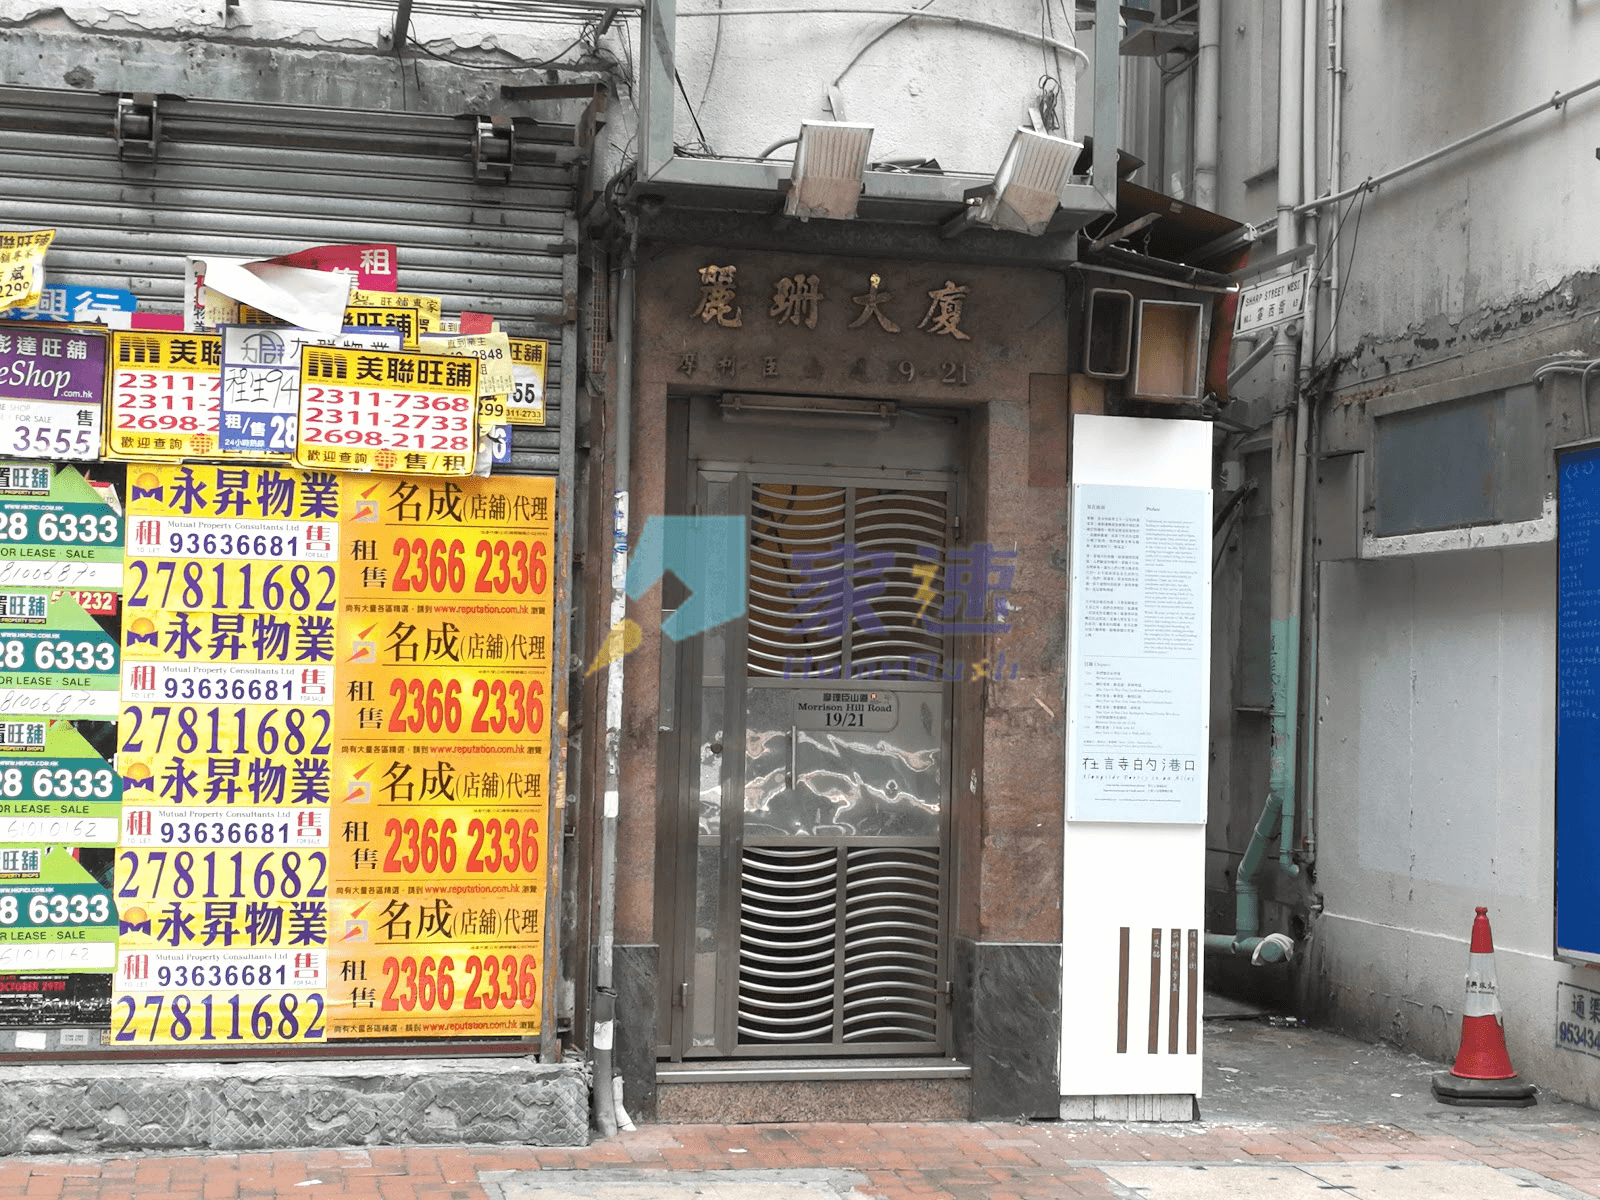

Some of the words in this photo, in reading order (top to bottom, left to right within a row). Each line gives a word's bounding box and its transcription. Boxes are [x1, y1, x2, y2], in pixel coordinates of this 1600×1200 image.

[360, 249, 391, 275] 租
[1246, 293, 1263, 305] SHARP
[1264, 285, 1285, 301] STREET
[1287, 279, 1301, 293] WEST
[356, 355, 472, 388] 美聯旺舖
[306, 387, 470, 412] 2311-7368
[16, 414, 30, 422] FOR
[34, 415, 51, 423] SALE
[77, 410, 93, 426] 售
[305, 407, 468, 432] 2311-2733
[13, 425, 91, 455] 3555
[120, 436, 184, 451] 歡迎查詢
[304, 427, 469, 451] 2698-2128
[307, 449, 368, 464] 歡迎查詢
[168, 467, 339, 519] 永昇物業
[38, 513, 118, 543] 6333
[136, 520, 161, 545] 租
[306, 525, 331, 551] 售
[20, 549, 55, 557] LEASE
[66, 550, 94, 558] SALE
[170, 533, 297, 557] 93636681
[351, 539, 378, 561] 租
[360, 566, 387, 589] 售
[392, 537, 465, 593] 2366
[474, 540, 547, 595] 2336
[128, 560, 336, 612] 27811682
[163, 612, 334, 662] 永昇物業
[35, 641, 115, 670] 6333
[17, 677, 52, 685] LEASE
[62, 678, 91, 686] SALE
[131, 665, 156, 691] 租
[164, 678, 292, 701] 93636681
[301, 669, 326, 694] 售
[346, 680, 375, 702] 租
[357, 707, 383, 730] 售
[388, 678, 462, 733] 2366
[471, 679, 544, 734] 2336
[798, 703, 843, 712] Morrison
[846, 703, 864, 712] Hill
[867, 704, 892, 712] Road
[122, 706, 331, 755] 27811682
[825, 712, 865, 727] 19/21
[33, 769, 113, 798] 6333
[160, 756, 330, 805] 永昇物業
[15, 805, 51, 813] LEASE
[61, 805, 89, 814] SALE
[127, 810, 152, 836] 租
[160, 822, 288, 843] 93636681
[297, 811, 322, 837] 售
[341, 821, 370, 843] 租
[383, 818, 457, 873] 2366
[466, 818, 539, 873] 2336
[352, 848, 379, 870] 售
[118, 851, 327, 899] 27811682
[29, 895, 109, 924] 6333
[11, 931, 46, 940] LEASE
[57, 931, 85, 939] SALE
[157, 901, 328, 947] 永昇物業
[124, 954, 149, 980] 租
[157, 964, 286, 987] 93636681
[294, 953, 319, 978] 售
[339, 959, 367, 982] 租
[381, 956, 455, 1012] 2366
[463, 954, 537, 1010] 2336
[350, 987, 376, 1009] 售
[115, 993, 325, 1041] 27811682
